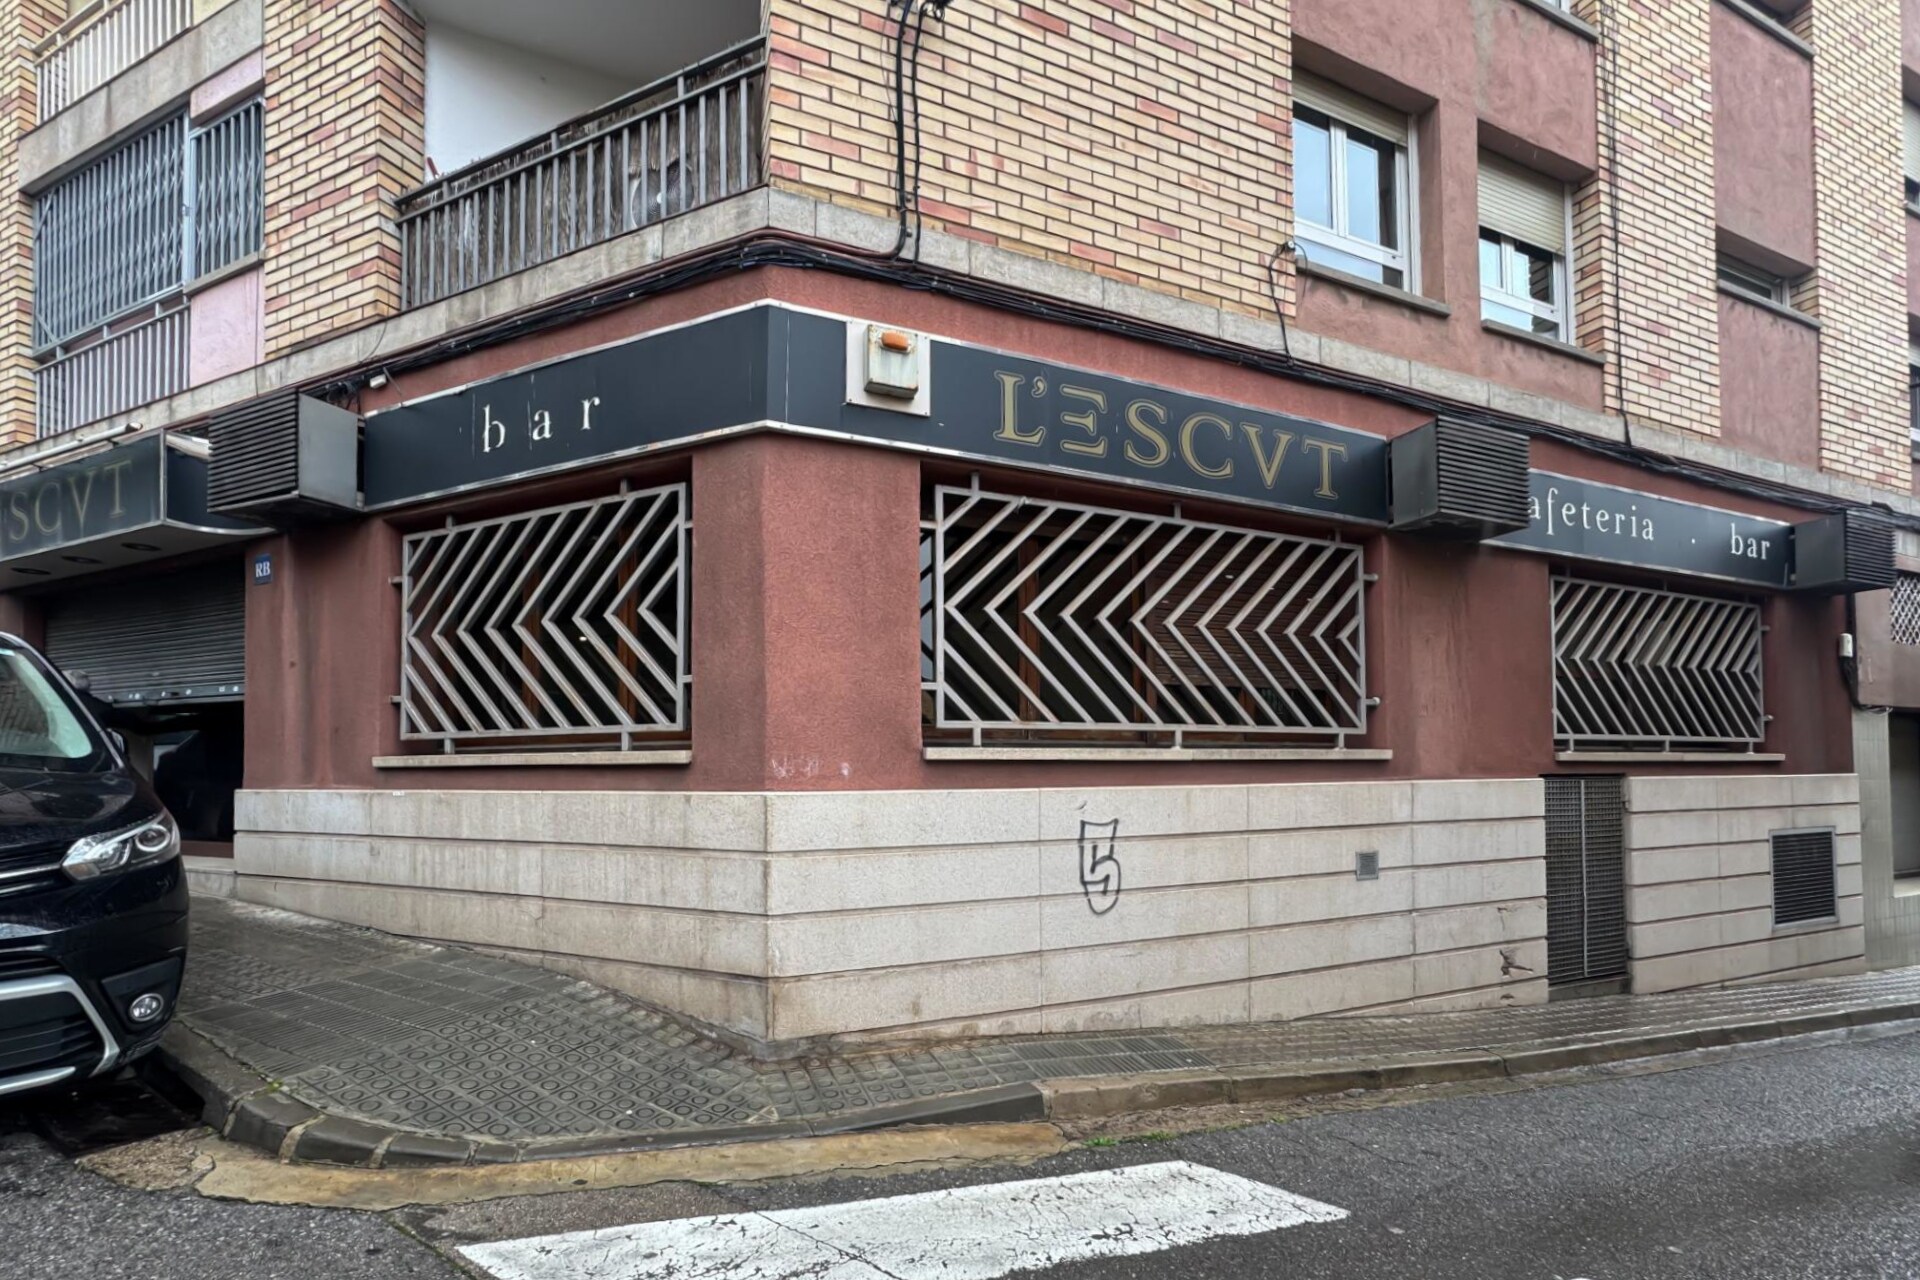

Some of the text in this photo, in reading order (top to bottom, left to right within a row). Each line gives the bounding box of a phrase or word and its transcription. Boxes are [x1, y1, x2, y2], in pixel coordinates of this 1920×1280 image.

[481, 396, 600, 453] bar
[2, 459, 133, 543] SCVT
[1527, 487, 1771, 560] afeteria bar
